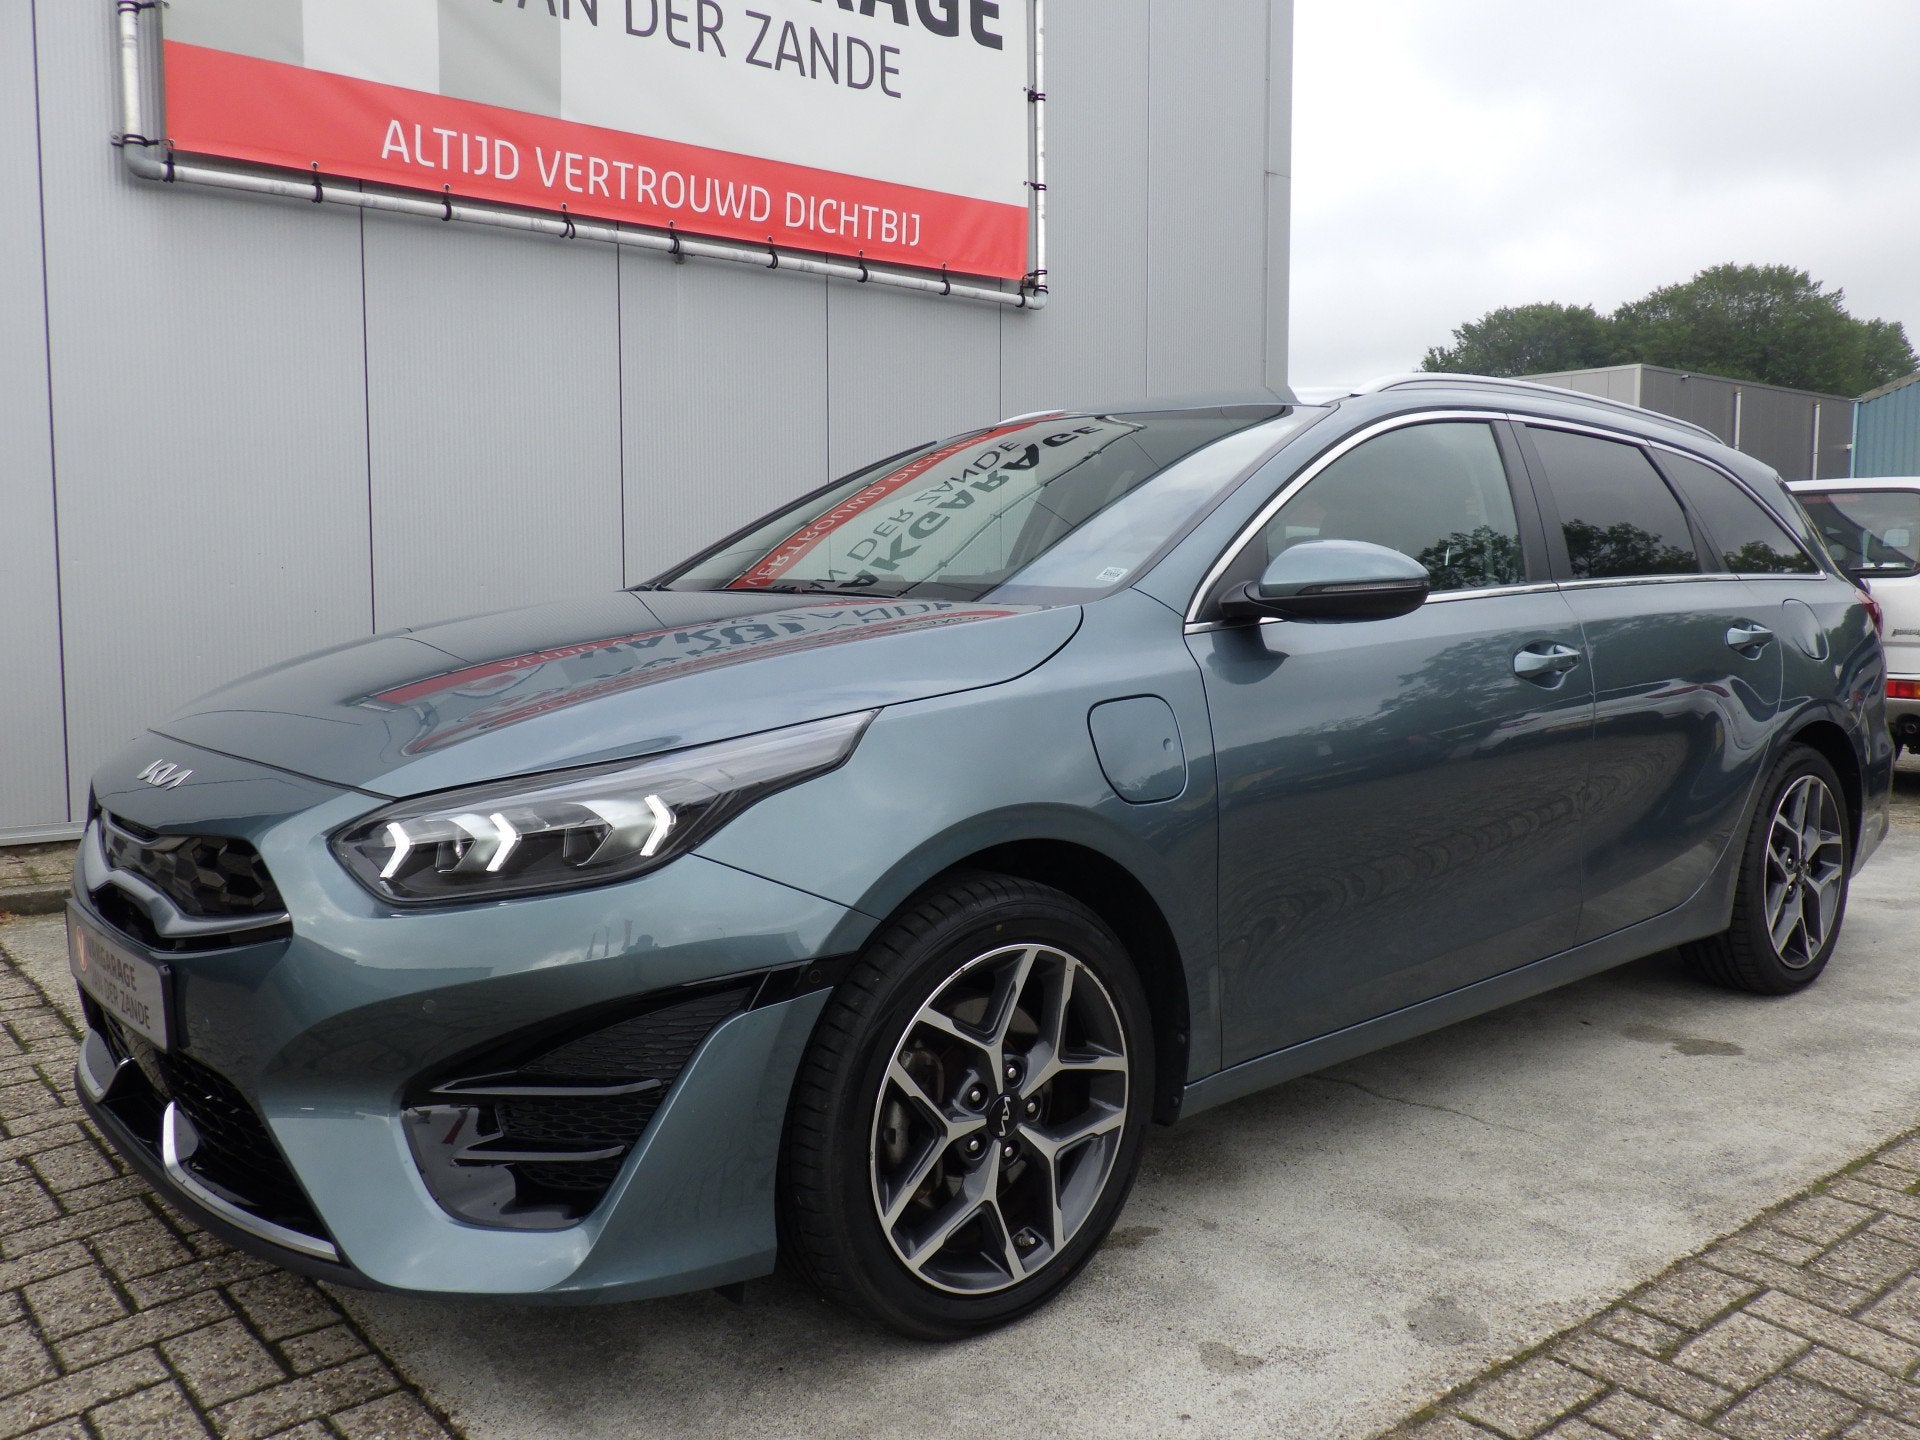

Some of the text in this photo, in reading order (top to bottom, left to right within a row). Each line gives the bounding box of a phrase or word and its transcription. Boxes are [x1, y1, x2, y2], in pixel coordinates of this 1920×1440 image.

[626, 0, 727, 58] DER
[745, 9, 902, 98] ZANDE
[381, 119, 921, 247] ALTIJD VERTROUWD DICHTBIJ
[120, 990, 151, 1031] ZANDE
